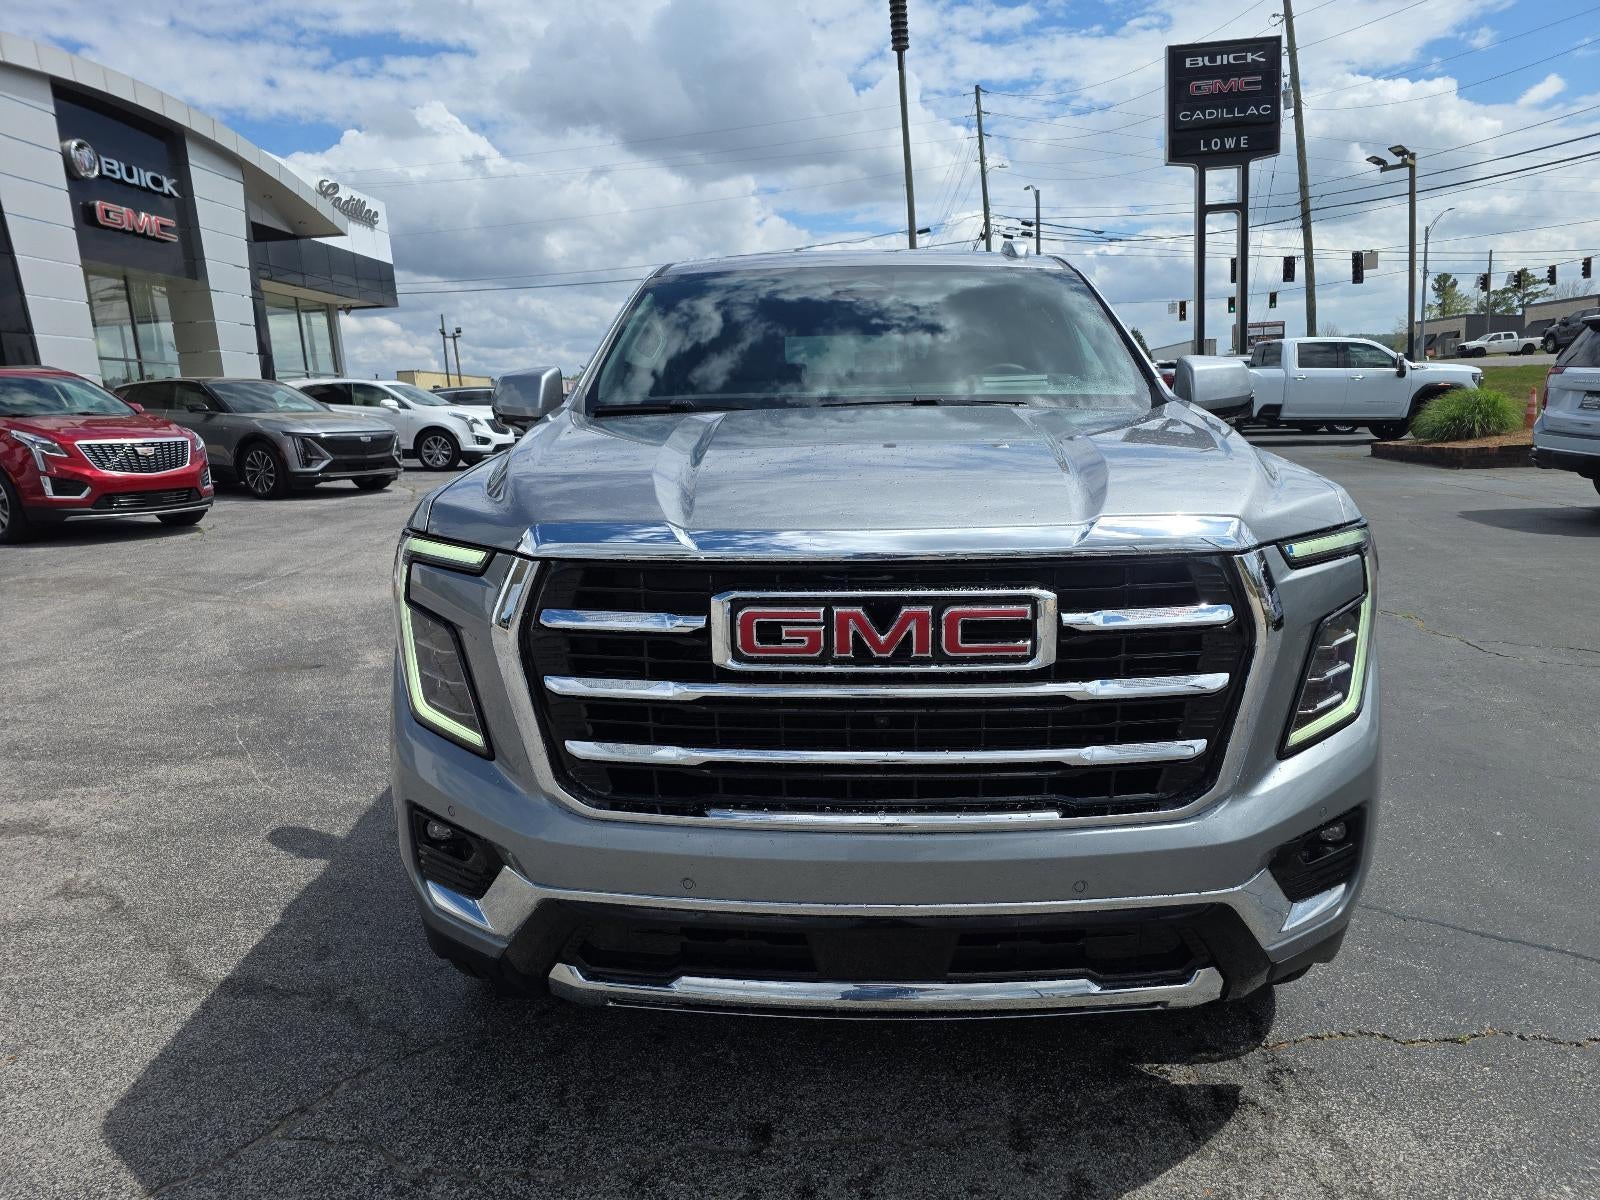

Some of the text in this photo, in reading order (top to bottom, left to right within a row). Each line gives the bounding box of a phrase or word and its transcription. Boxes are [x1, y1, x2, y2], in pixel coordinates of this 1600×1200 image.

[1185, 51, 1266, 69] BUICK
[1189, 75, 1262, 96] GMC
[1180, 104, 1271, 121] CADILLAC
[1200, 136, 1249, 151] LOWE
[99, 155, 181, 199] BUICK
[315, 179, 379, 225] Cadillac
[96, 201, 178, 242] GMC
[736, 606, 1032, 658] GMC
